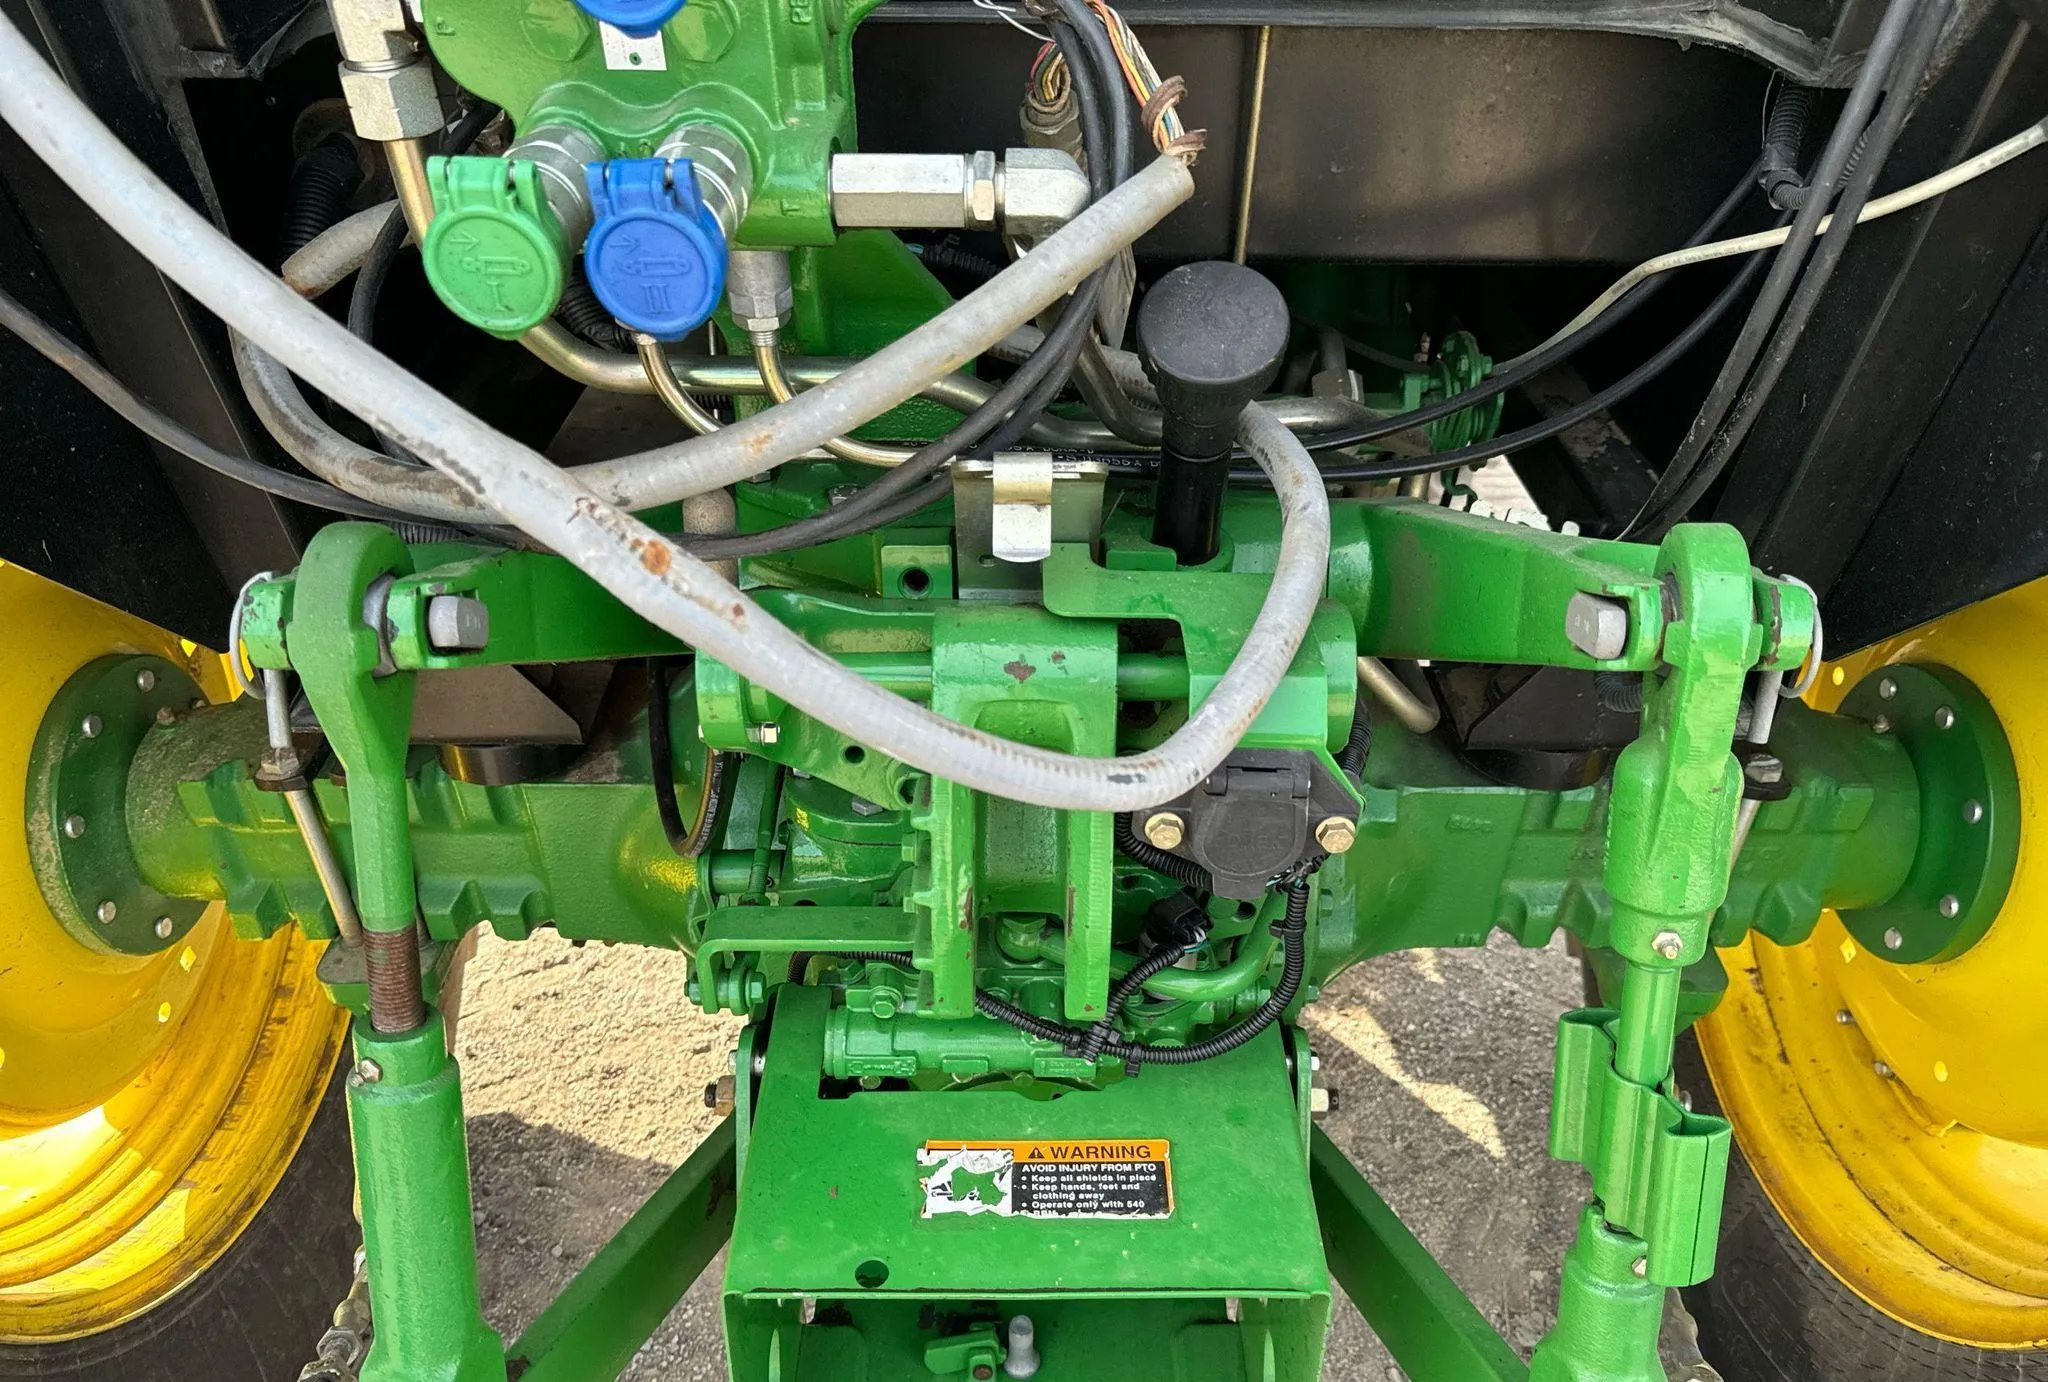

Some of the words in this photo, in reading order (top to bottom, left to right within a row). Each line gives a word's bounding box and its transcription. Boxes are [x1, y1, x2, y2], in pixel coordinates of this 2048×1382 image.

[1049, 1145, 1151, 1159] WARNING
[1022, 1164, 1057, 1172] AVOID
[1058, 1163, 1099, 1172] INJURY
[1100, 1163, 1132, 1172] FROM
[1134, 1163, 1157, 1172] PTO
[1031, 1174, 1058, 1183] Keep
[1129, 1174, 1157, 1182] place
[1031, 1183, 1058, 1192] Keep
[1060, 1183, 1095, 1191] hands,
[1121, 1182, 1140, 1190] and
[1032, 1192, 1076, 1201] clothing
[1078, 1193, 1105, 1201] away
[1031, 1201, 1073, 1210] Operate
[1076, 1200, 1099, 1209] only
[1101, 1200, 1124, 1208] with
[1126, 1200, 1145, 1208] 540
